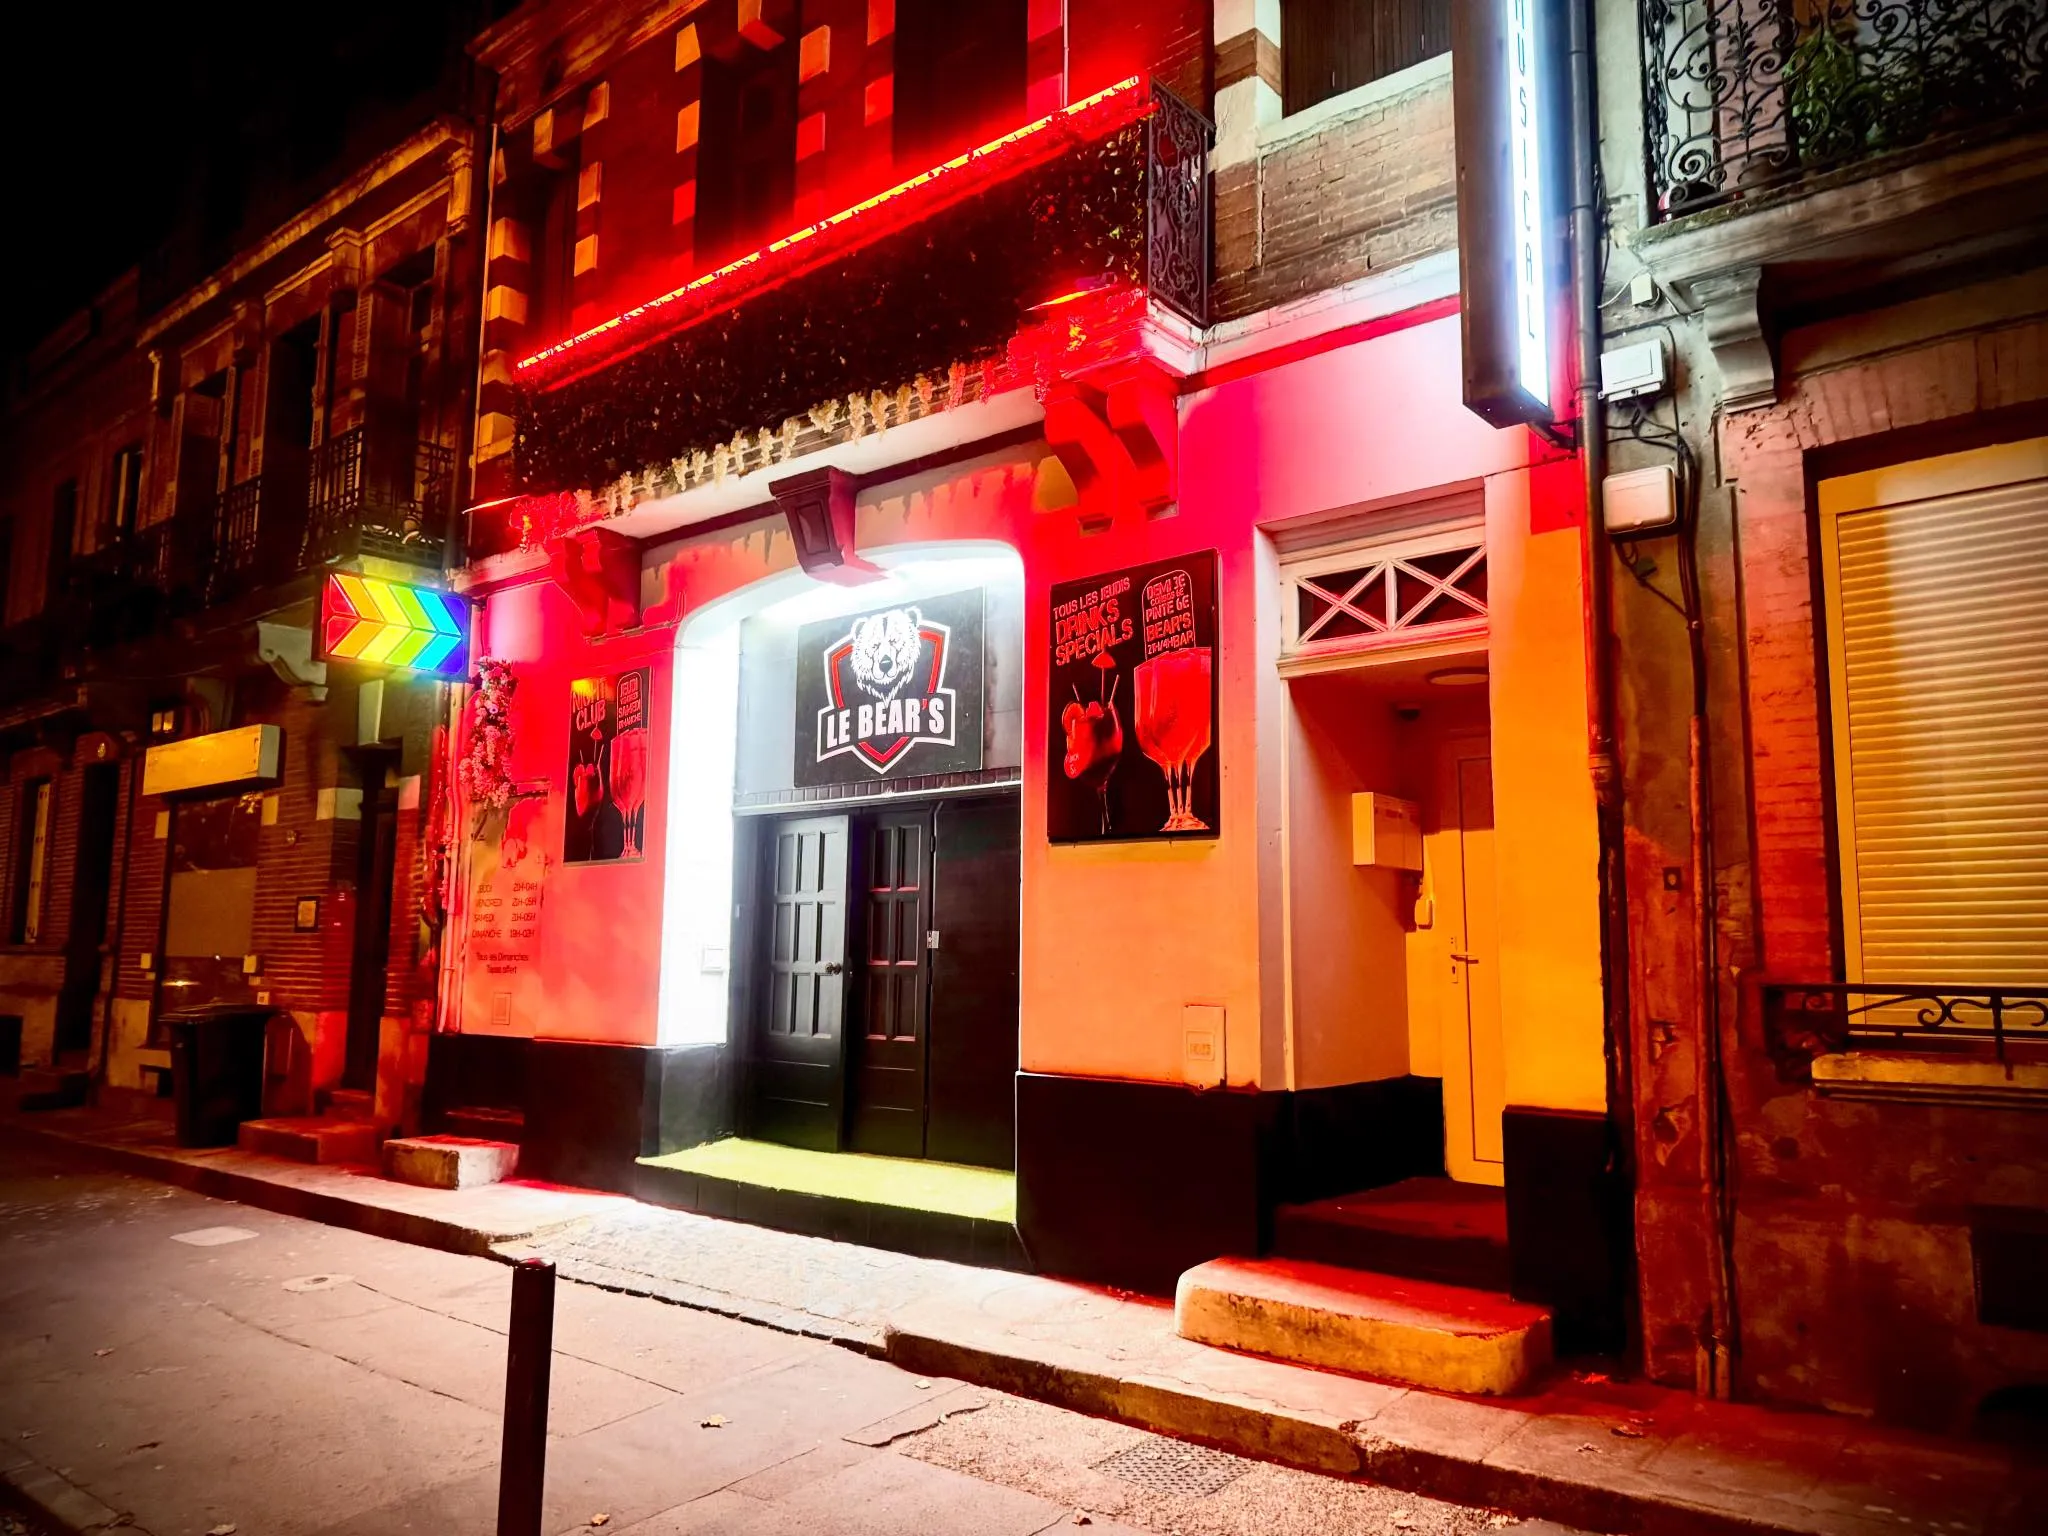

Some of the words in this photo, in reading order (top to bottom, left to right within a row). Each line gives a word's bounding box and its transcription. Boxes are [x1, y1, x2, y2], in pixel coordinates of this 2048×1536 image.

[1053, 599, 1078, 620] TOUS
[1080, 591, 1099, 609] LES
[1100, 577, 1131, 601] JEUDIS
[1146, 578, 1172, 601] DEMI
[1056, 598, 1120, 645] DRINKS
[1145, 600, 1175, 623] PINTE
[1176, 594, 1190, 611] 6E
[1056, 618, 1133, 666] SPECIALS
[1146, 612, 1192, 642] BEAR'S
[572, 678, 607, 714] NIGHT
[575, 699, 606, 731] CLUB
[827, 709, 851, 749] LE
[858, 697, 945, 739] BEAR'S
